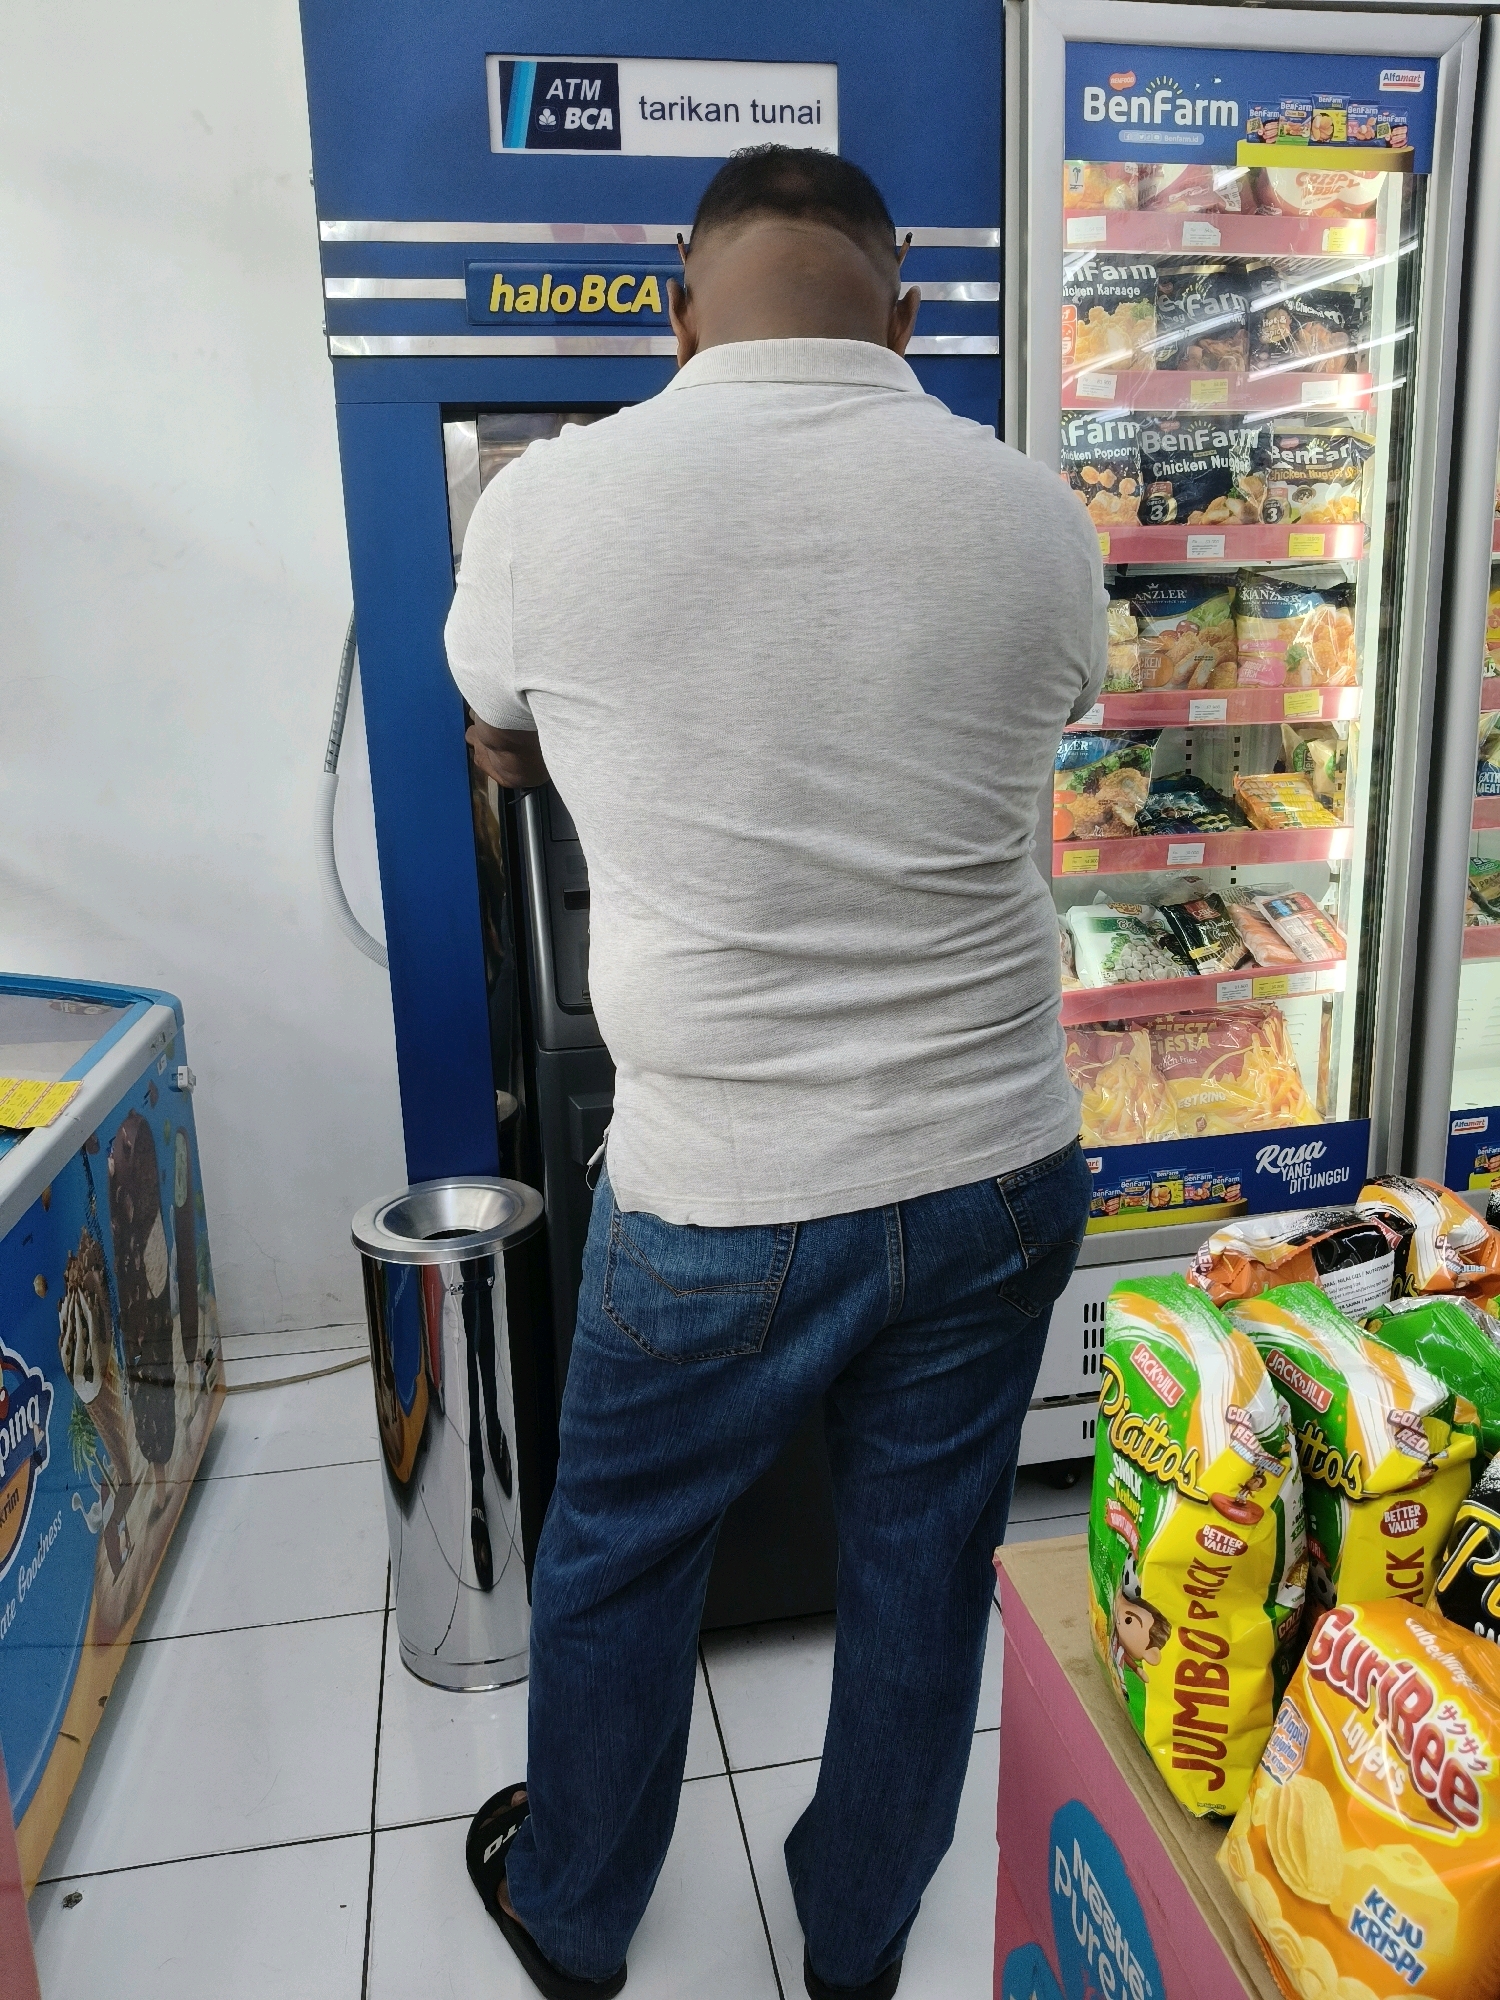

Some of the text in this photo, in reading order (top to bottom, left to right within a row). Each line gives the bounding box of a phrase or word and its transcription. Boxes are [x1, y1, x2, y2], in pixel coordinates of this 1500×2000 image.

[1383, 73, 1421, 83] Alfamart
[545, 78, 602, 101] ATM
[639, 95, 821, 125] tarikan tunai
[1084, 86, 1239, 127] BenFarm
[1280, 101, 1313, 112] BenFarm
[564, 107, 614, 131] BCA
[1164, 134, 1199, 144] Benfarm.id
[1295, 171, 1361, 189] CRISPY
[1065, 262, 1157, 282] nFarm
[489, 273, 662, 313] haloBCA
[1097, 284, 1141, 298] Karaage
[1061, 418, 1141, 447] nFarm
[1141, 428, 1261, 455] BenFarm
[1061, 446, 1138, 462] hicken Popcorn
[1271, 444, 1350, 465] BenFar
[1153, 458, 1208, 477] Chicken
[1269, 469, 1307, 481] Chicken
[1150, 505, 1164, 521] 3
[1267, 507, 1279, 521] 3
[1135, 589, 1187, 600] ANZLER
[1140, 656, 1161, 668] CKEN
[1151, 1032, 1212, 1056] FIESTA
[1180, 1055, 1198, 1065] Fries
[1178, 1091, 1227, 1109] ESTRING
[1454, 1119, 1486, 1128] Alfamart
[1255, 1140, 1327, 1174] Rasa
[1184, 1174, 1213, 1182] BenFarm
[1212, 1176, 1240, 1185] BenFarm
[1281, 1162, 1312, 1182] YANG
[1289, 1166, 1350, 1195] DITUNGGU
[1120, 1179, 1151, 1189] BenFarm
[1099, 1353, 1209, 1504] Piattos
[1299, 1420, 1382, 1502] ttos
[1113, 1452, 1143, 1501] SNACK
[1383, 1503, 1422, 1523] BETTER
[1202, 1524, 1244, 1549] BETTER
[1388, 1518, 1420, 1534] VALUE
[19, 1510, 62, 1603] Goodness
[1203, 1537, 1237, 1556] VALUE
[1385, 1546, 1425, 1608] ACK
[1182, 1556, 1233, 1621] PACK
[1172, 1627, 1231, 1792] JUMBO
[1306, 1607, 1481, 1828] GuriBee
[1437, 1704, 1488, 1772] サクサク
[1341, 1710, 1409, 1797] Layers
[1363, 1887, 1425, 1950] KEJU
[1349, 1906, 1426, 1985] KRISPI
